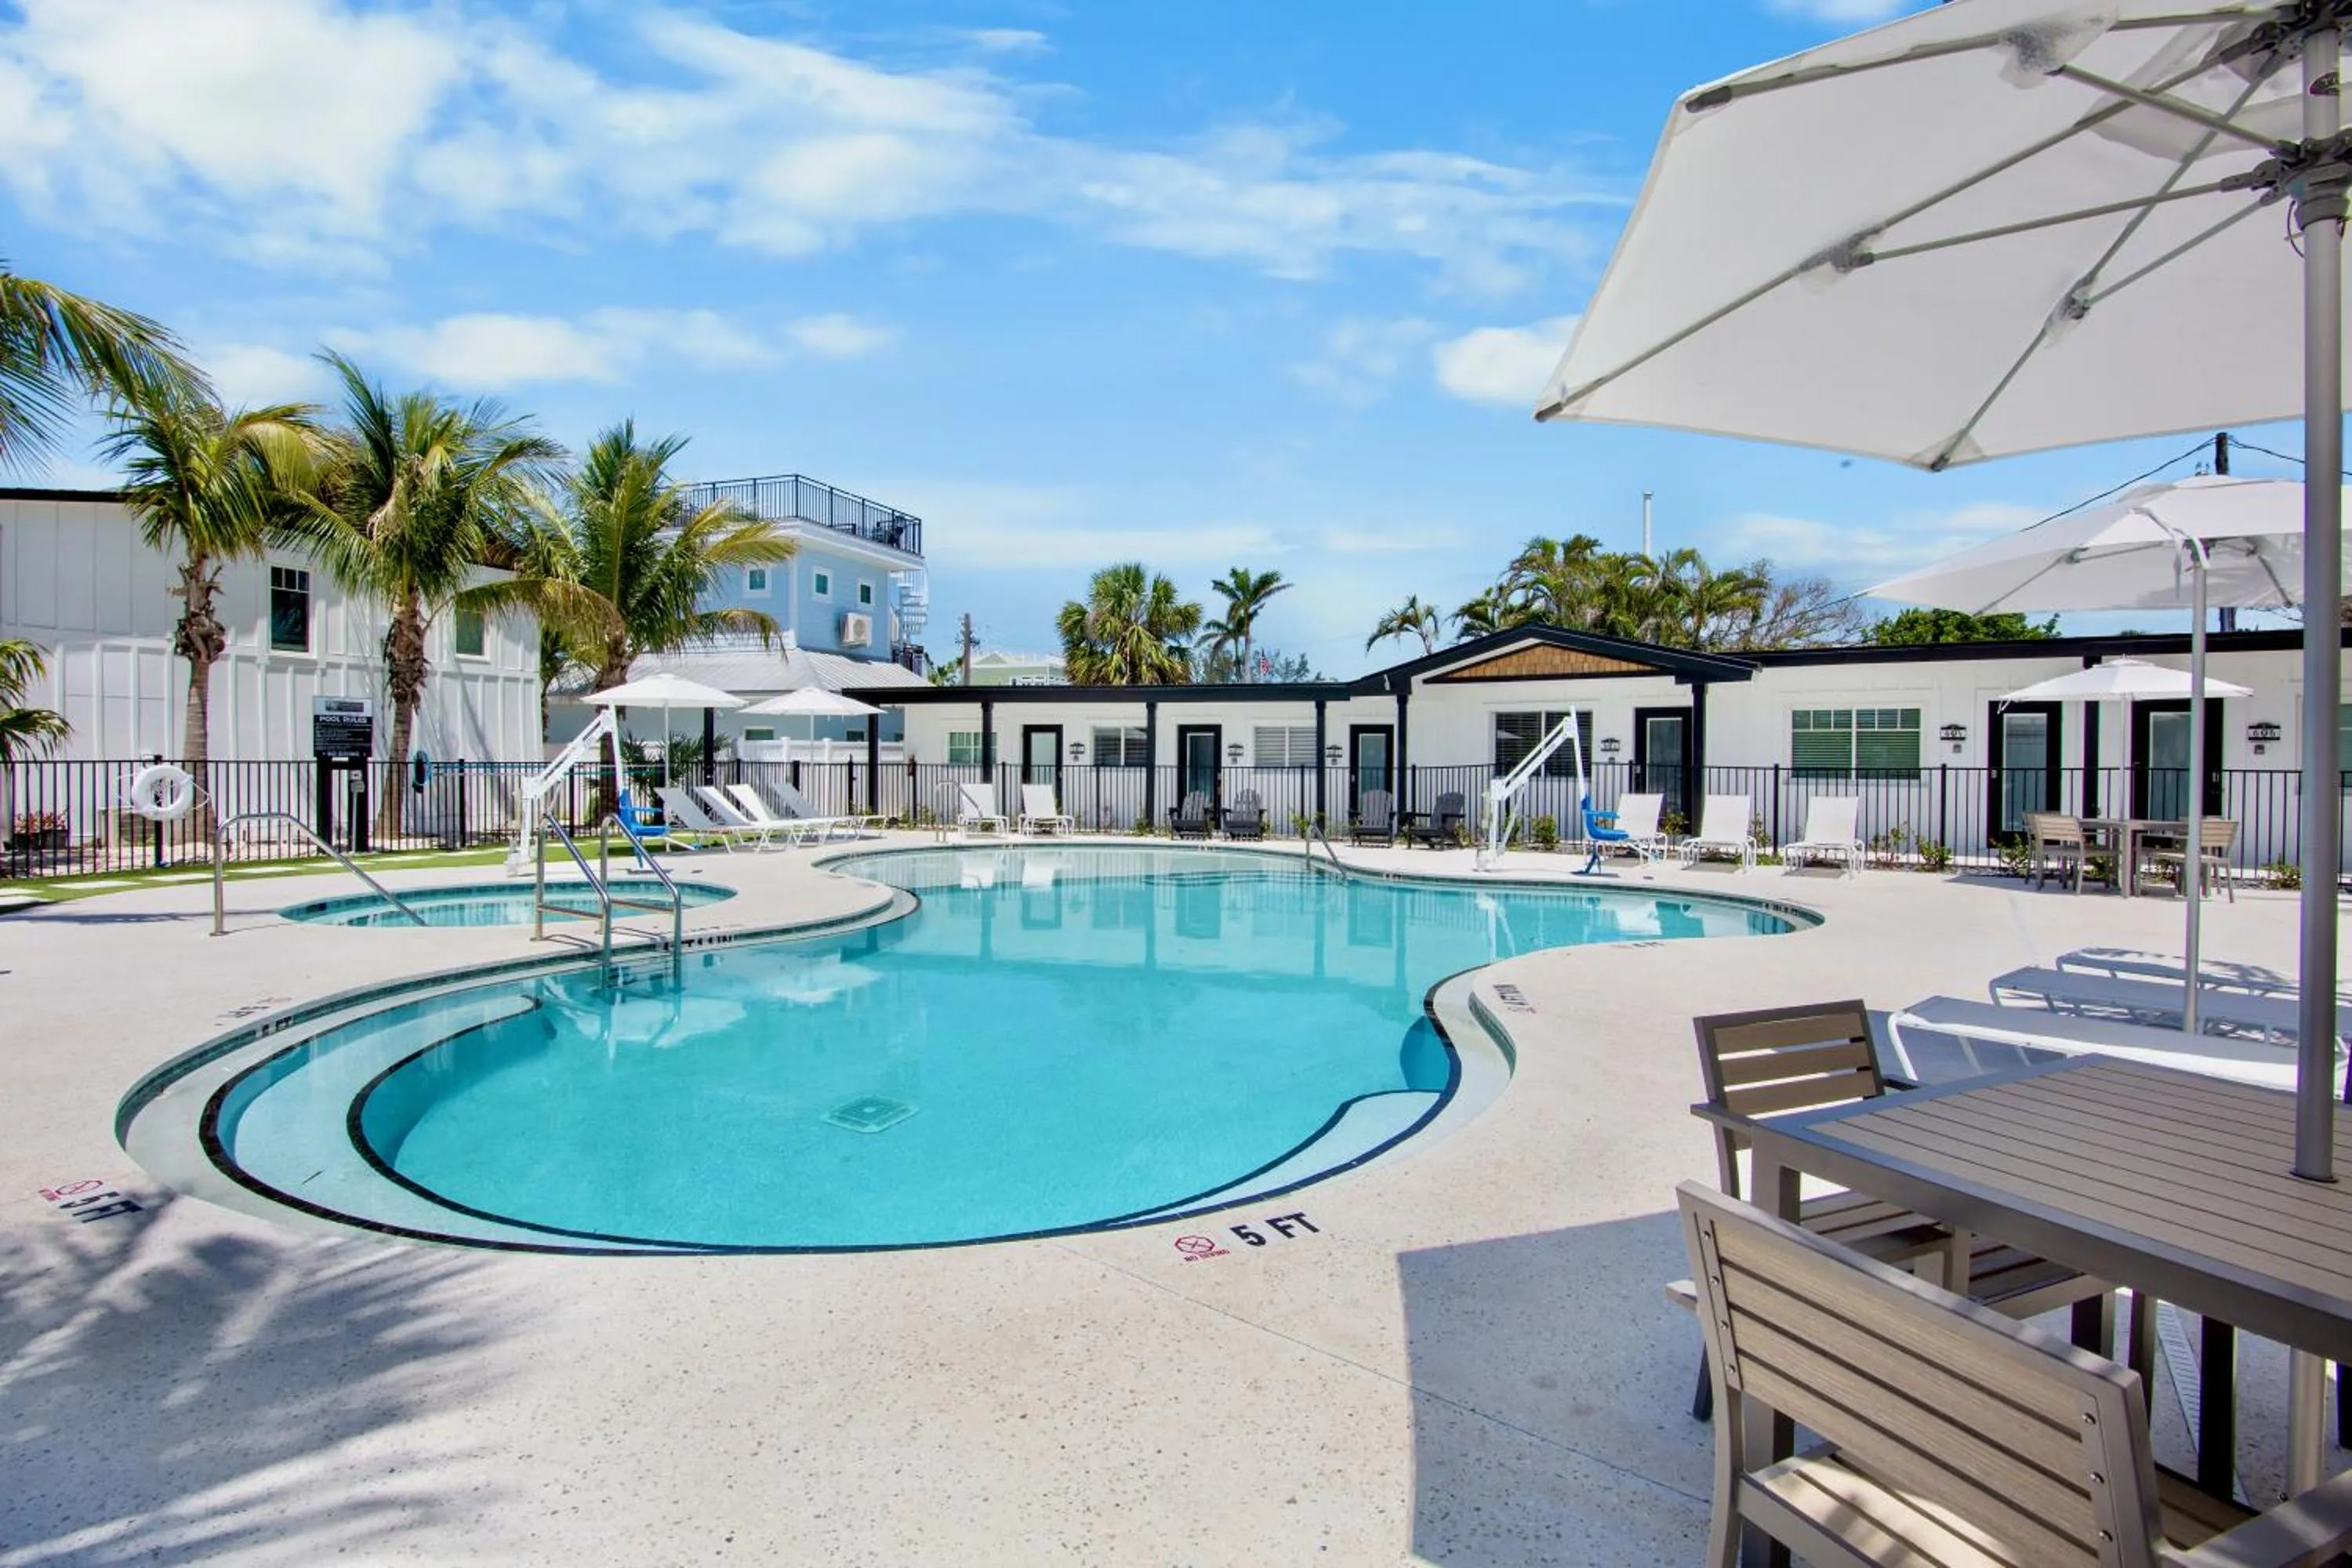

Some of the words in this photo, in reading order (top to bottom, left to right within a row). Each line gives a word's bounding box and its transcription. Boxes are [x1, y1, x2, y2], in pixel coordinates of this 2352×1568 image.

[59, 1191, 121, 1209] 5
[72, 1200, 144, 1224] FT
[1229, 1225, 1267, 1247] 5
[1265, 1212, 1320, 1240] FT
